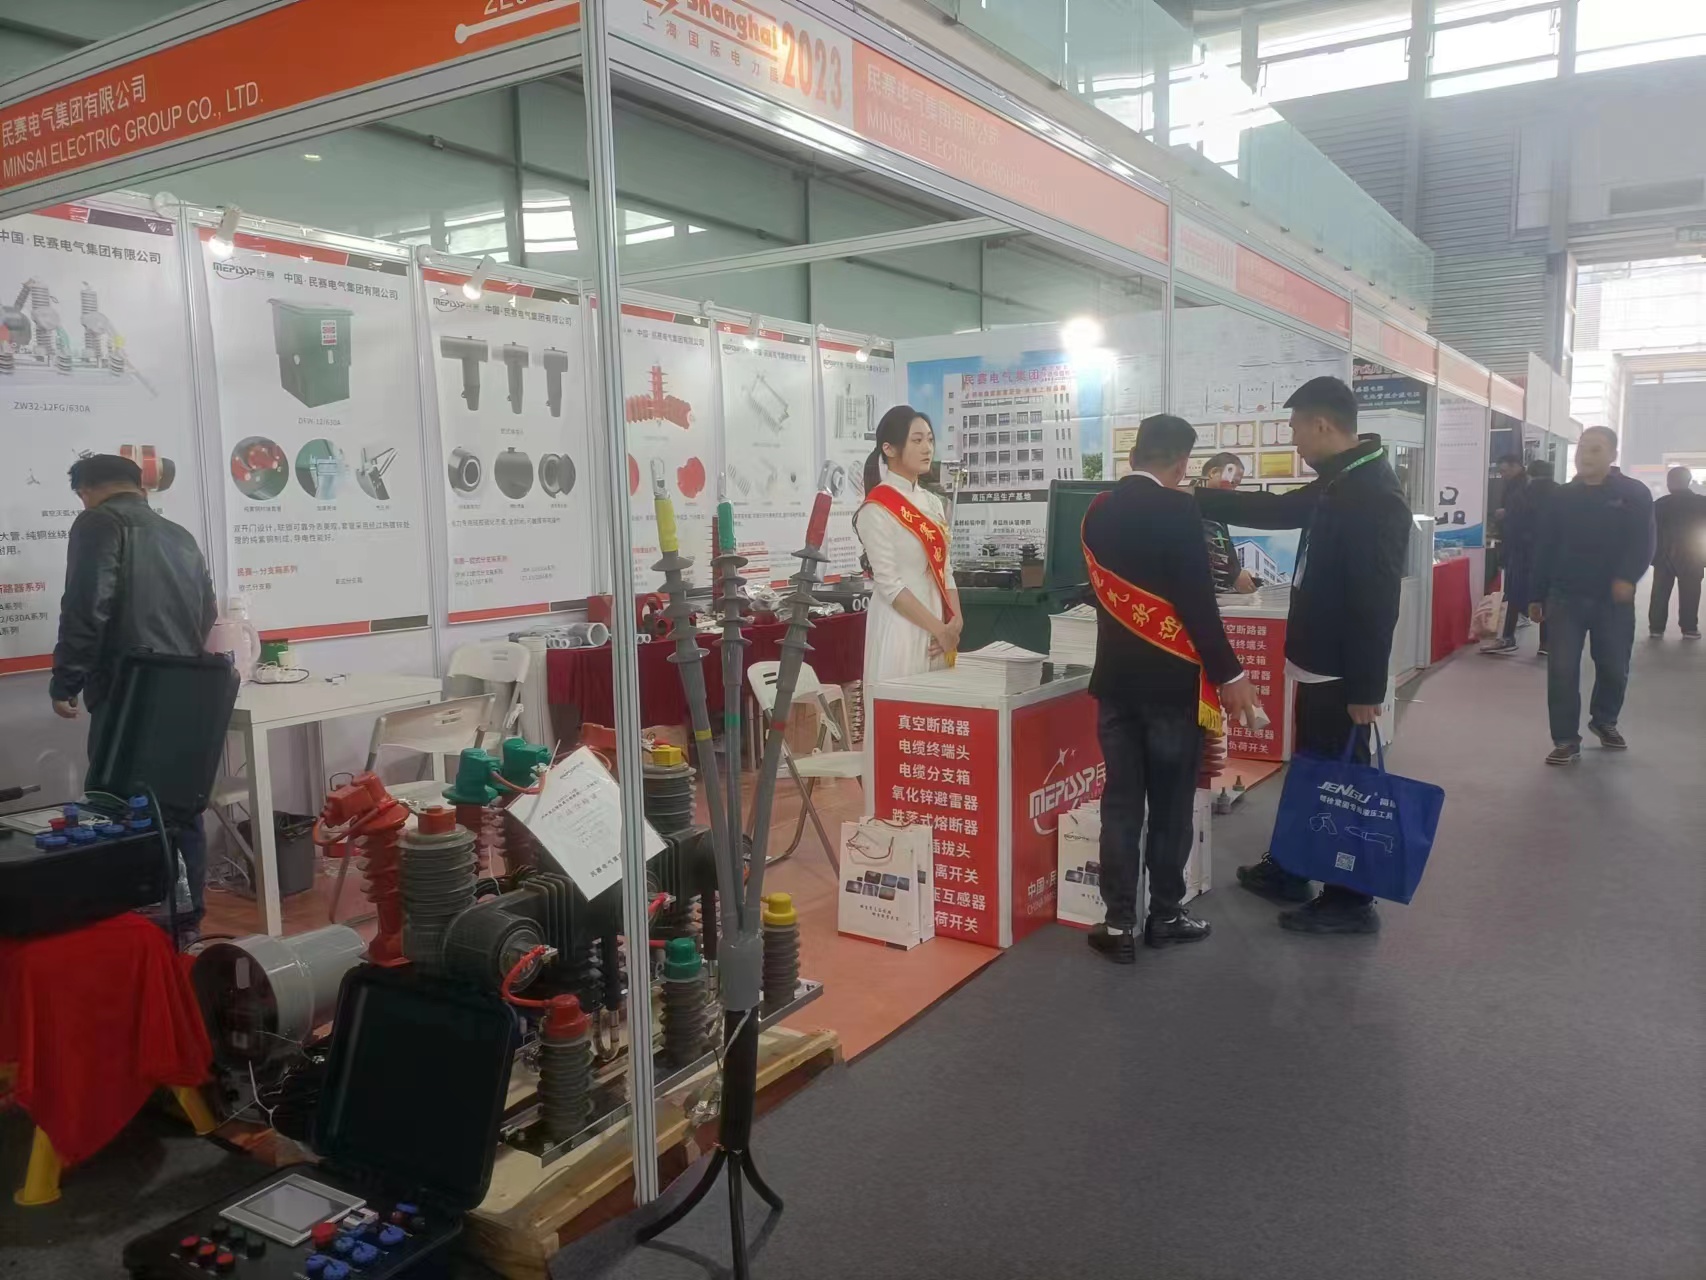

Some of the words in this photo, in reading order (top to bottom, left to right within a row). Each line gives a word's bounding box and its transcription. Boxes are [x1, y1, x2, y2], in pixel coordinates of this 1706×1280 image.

[781, 20, 842, 110] 2023
[2, 74, 146, 148] 民赛电气集团有限公司
[3, 151, 48, 179] MINSAI
[51, 123, 122, 165] ELECTRIC
[124, 105, 182, 142] GROUP
[187, 96, 222, 124] CO.,
[226, 81, 264, 113] LTD.
[868, 111, 914, 145] MINSAI
[0, 581, 46, 594] 路器系列
[1222, 623, 1267, 637] 空断路器
[898, 714, 970, 737] 真空断路器
[898, 738, 970, 761] 电缆终端头
[1228, 740, 1269, 754] 负荷开关
[898, 762, 971, 786] 电缆分支箱
[891, 784, 979, 812] 氧化锌避雷器
[1317, 781, 1371, 804] JENGU
